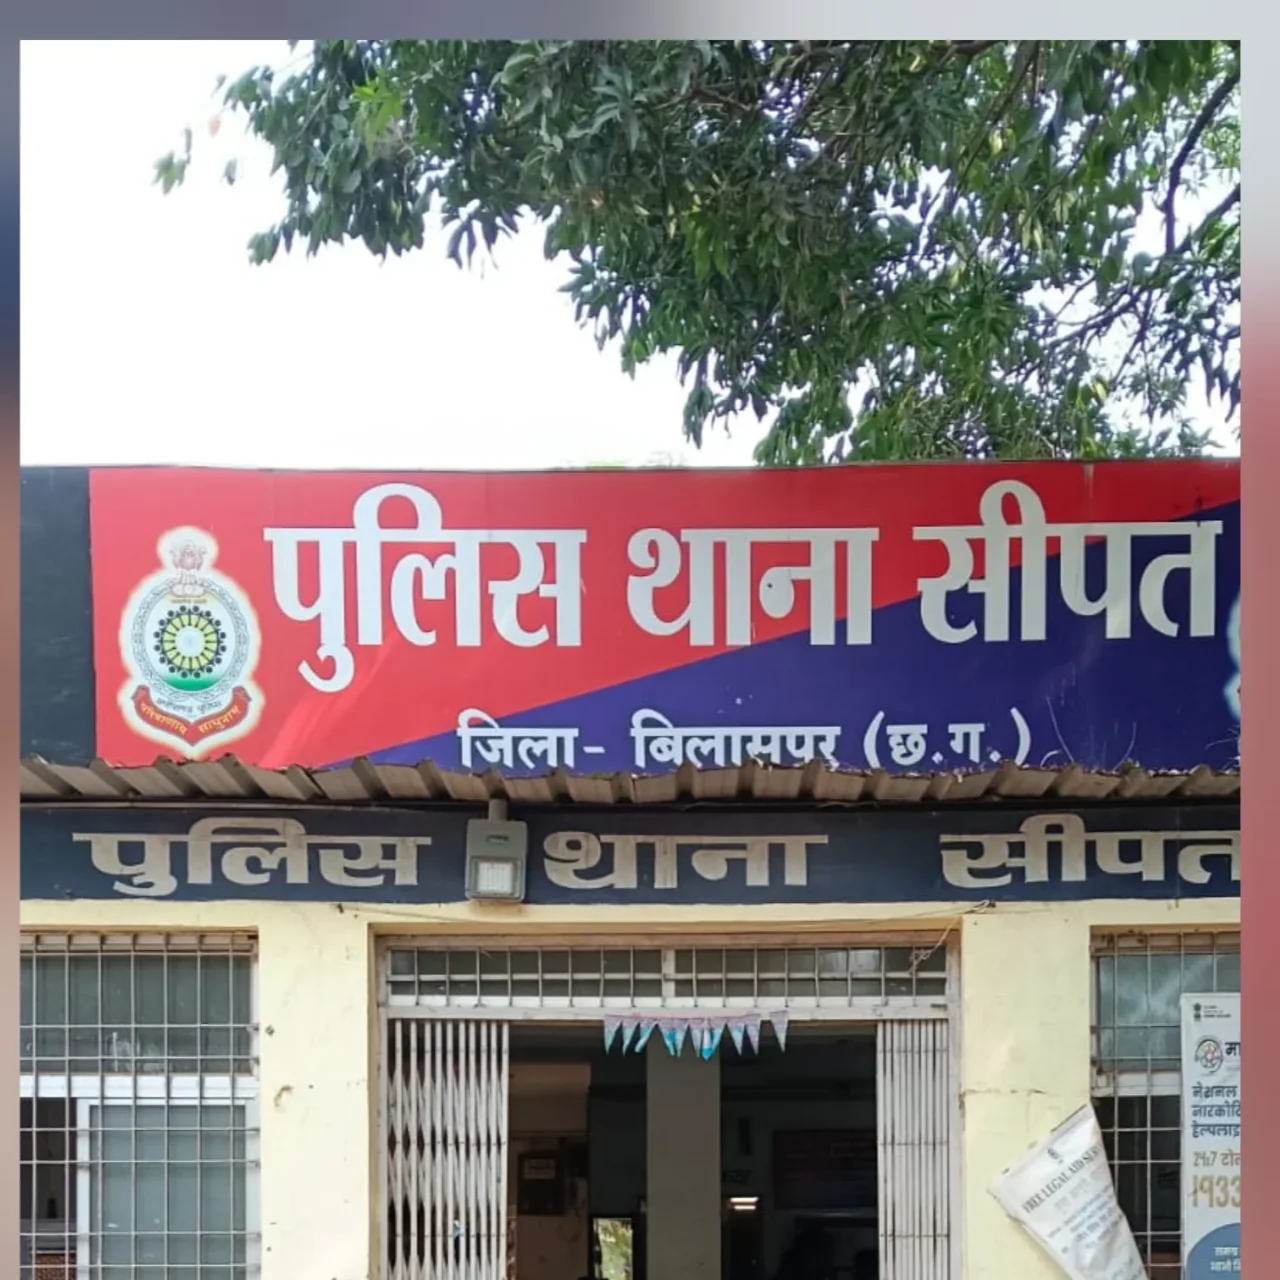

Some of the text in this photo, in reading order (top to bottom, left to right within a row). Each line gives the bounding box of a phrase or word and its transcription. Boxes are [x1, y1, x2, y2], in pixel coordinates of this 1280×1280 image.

[263, 479, 1224, 693] पुलिस थाना सीपत
[72, 813, 1241, 897] पुलिस थाना सीपत
